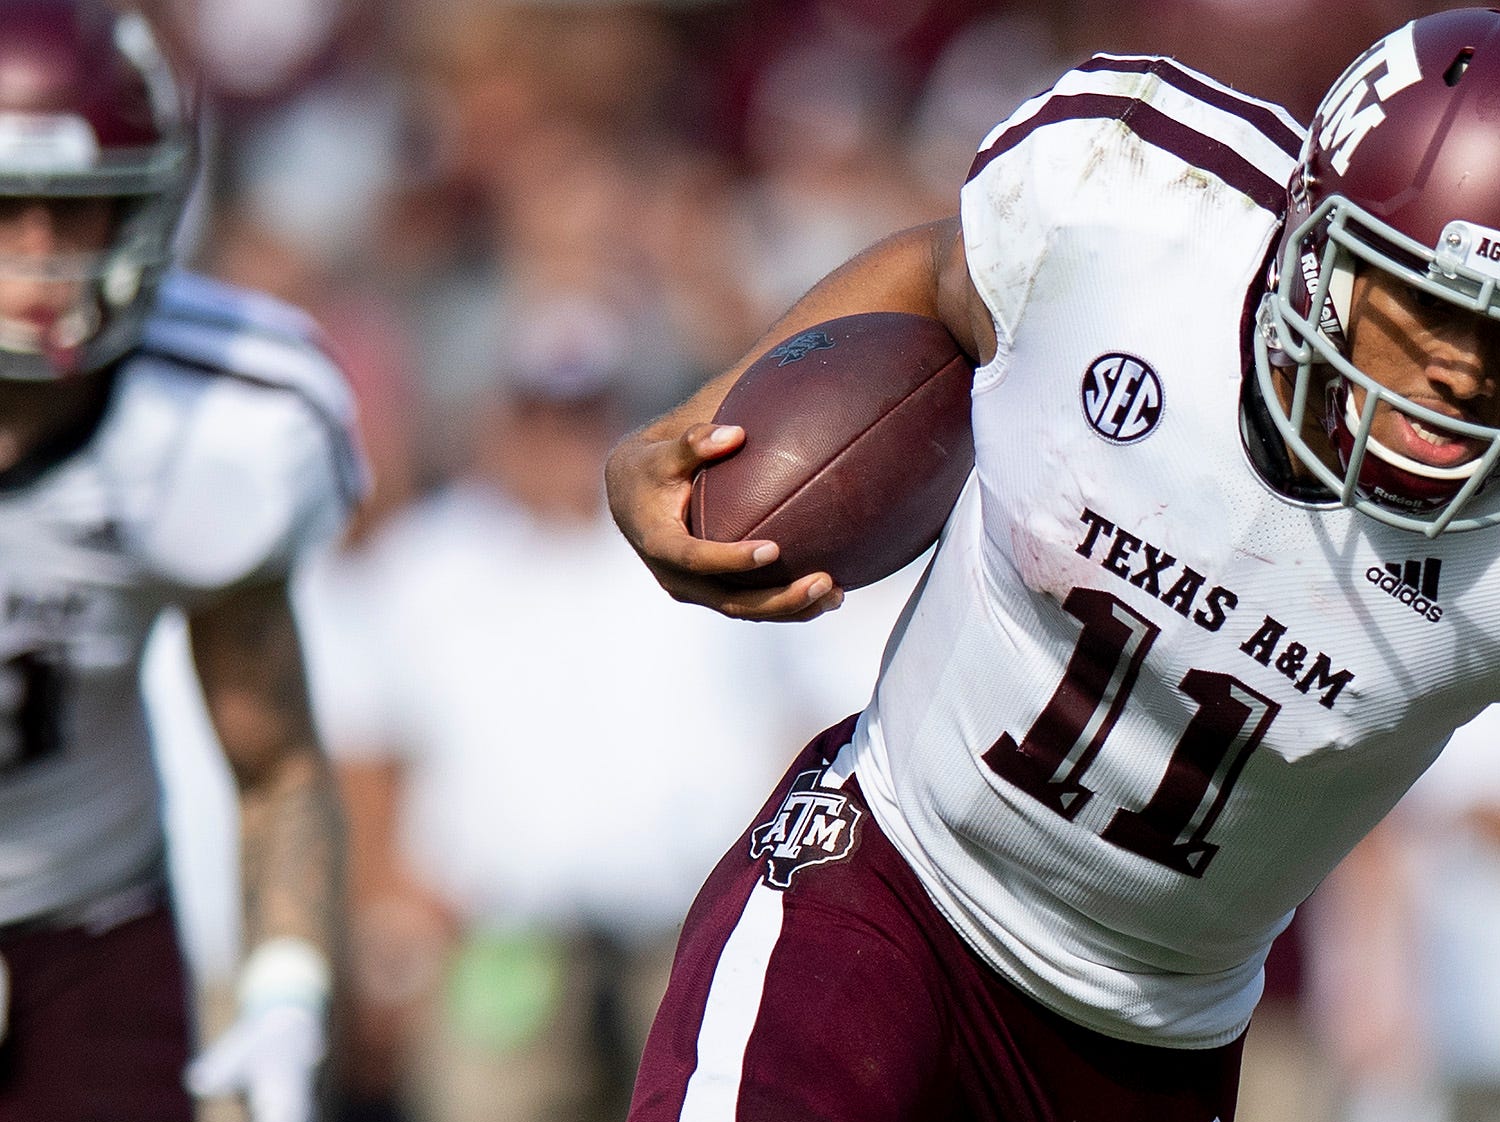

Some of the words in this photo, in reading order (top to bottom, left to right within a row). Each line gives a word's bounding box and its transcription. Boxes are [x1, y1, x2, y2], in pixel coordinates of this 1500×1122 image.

[1083, 356, 1160, 440] SEC
[1074, 507, 1239, 632] TEXAS
[1238, 614, 1356, 710] A&M
[1365, 565, 1444, 624] adidas
[980, 586, 1282, 880] 11
